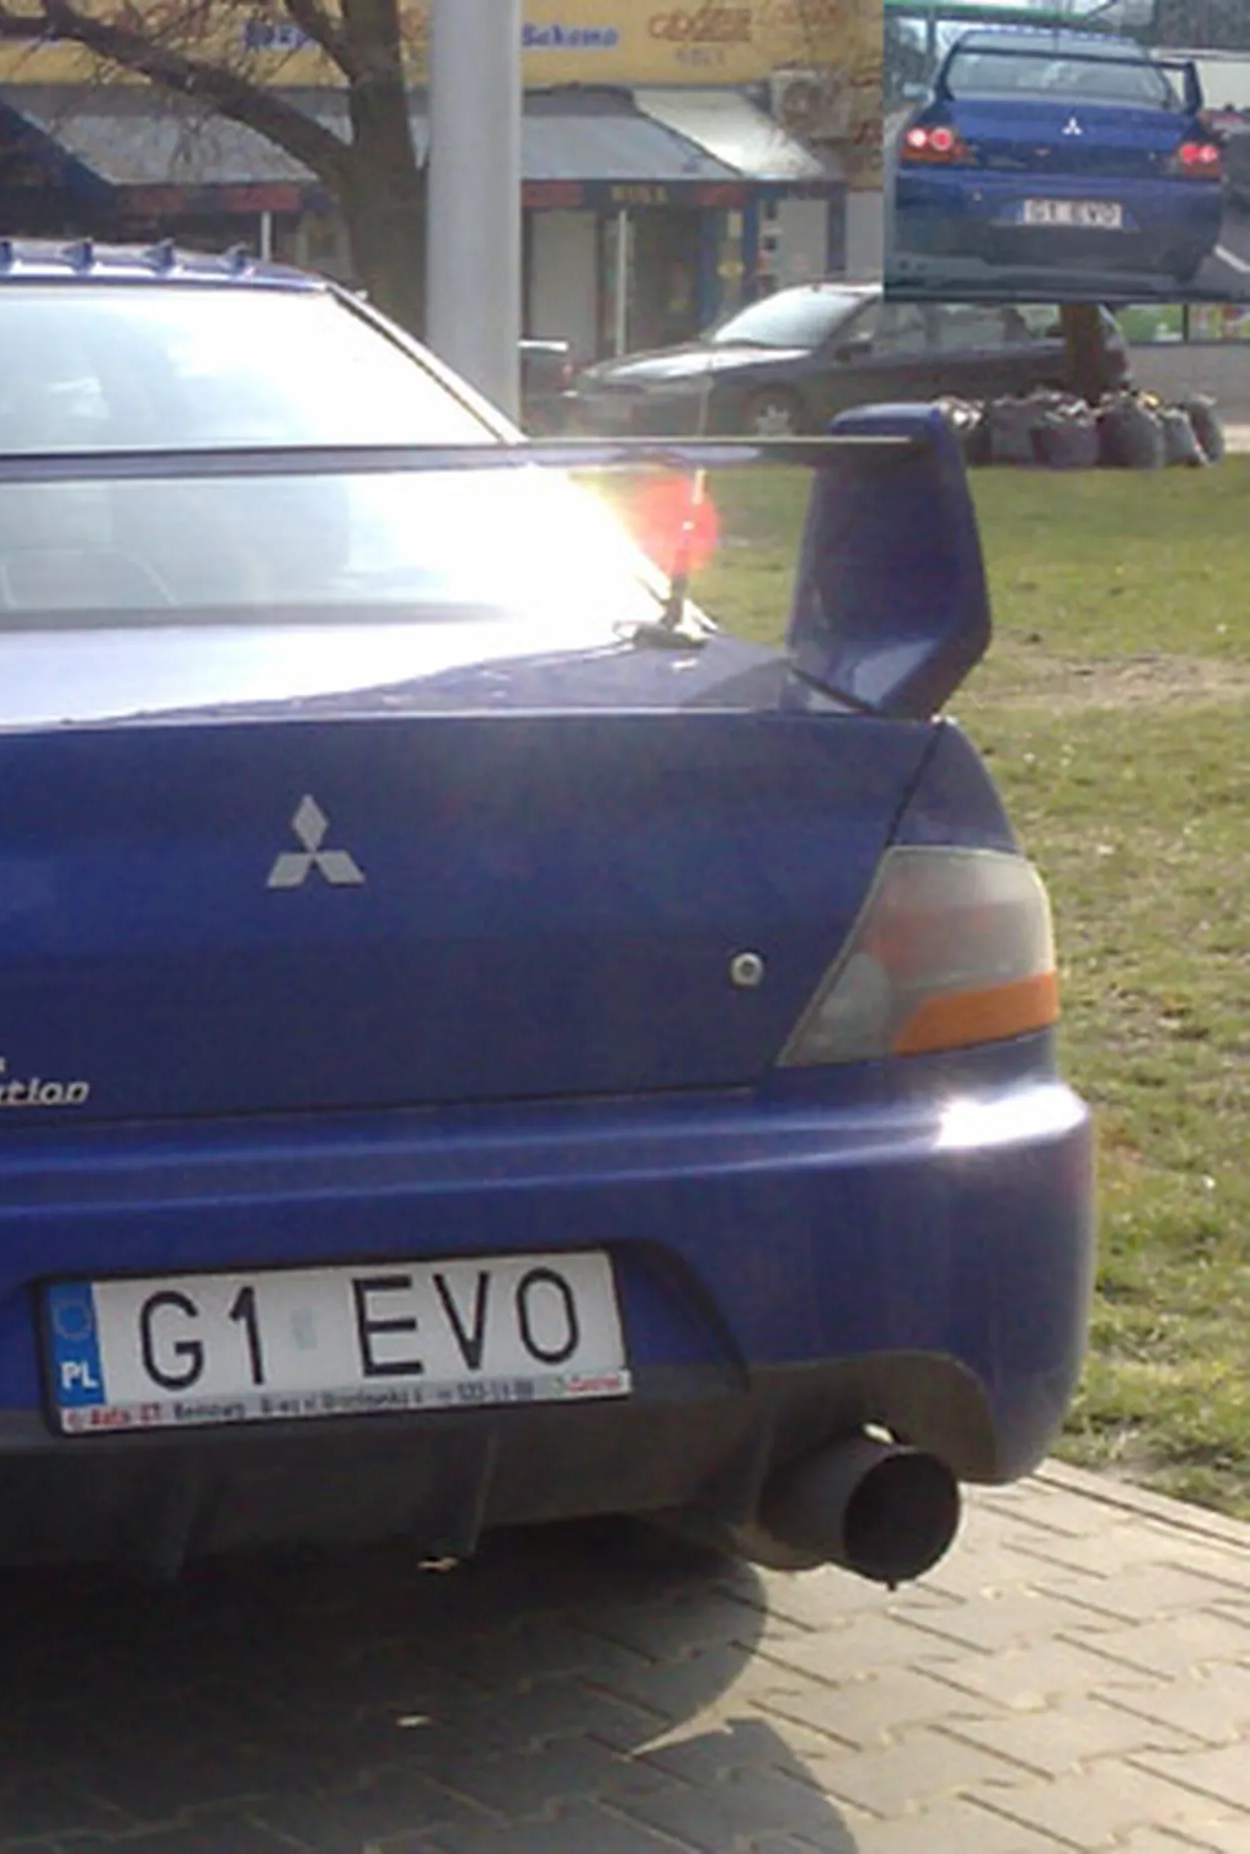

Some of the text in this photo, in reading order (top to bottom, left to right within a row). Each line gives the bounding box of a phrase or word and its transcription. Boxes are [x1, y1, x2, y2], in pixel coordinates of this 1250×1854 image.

[139, 1267, 580, 1390] G1 EVO
[61, 1361, 98, 1390] PL
